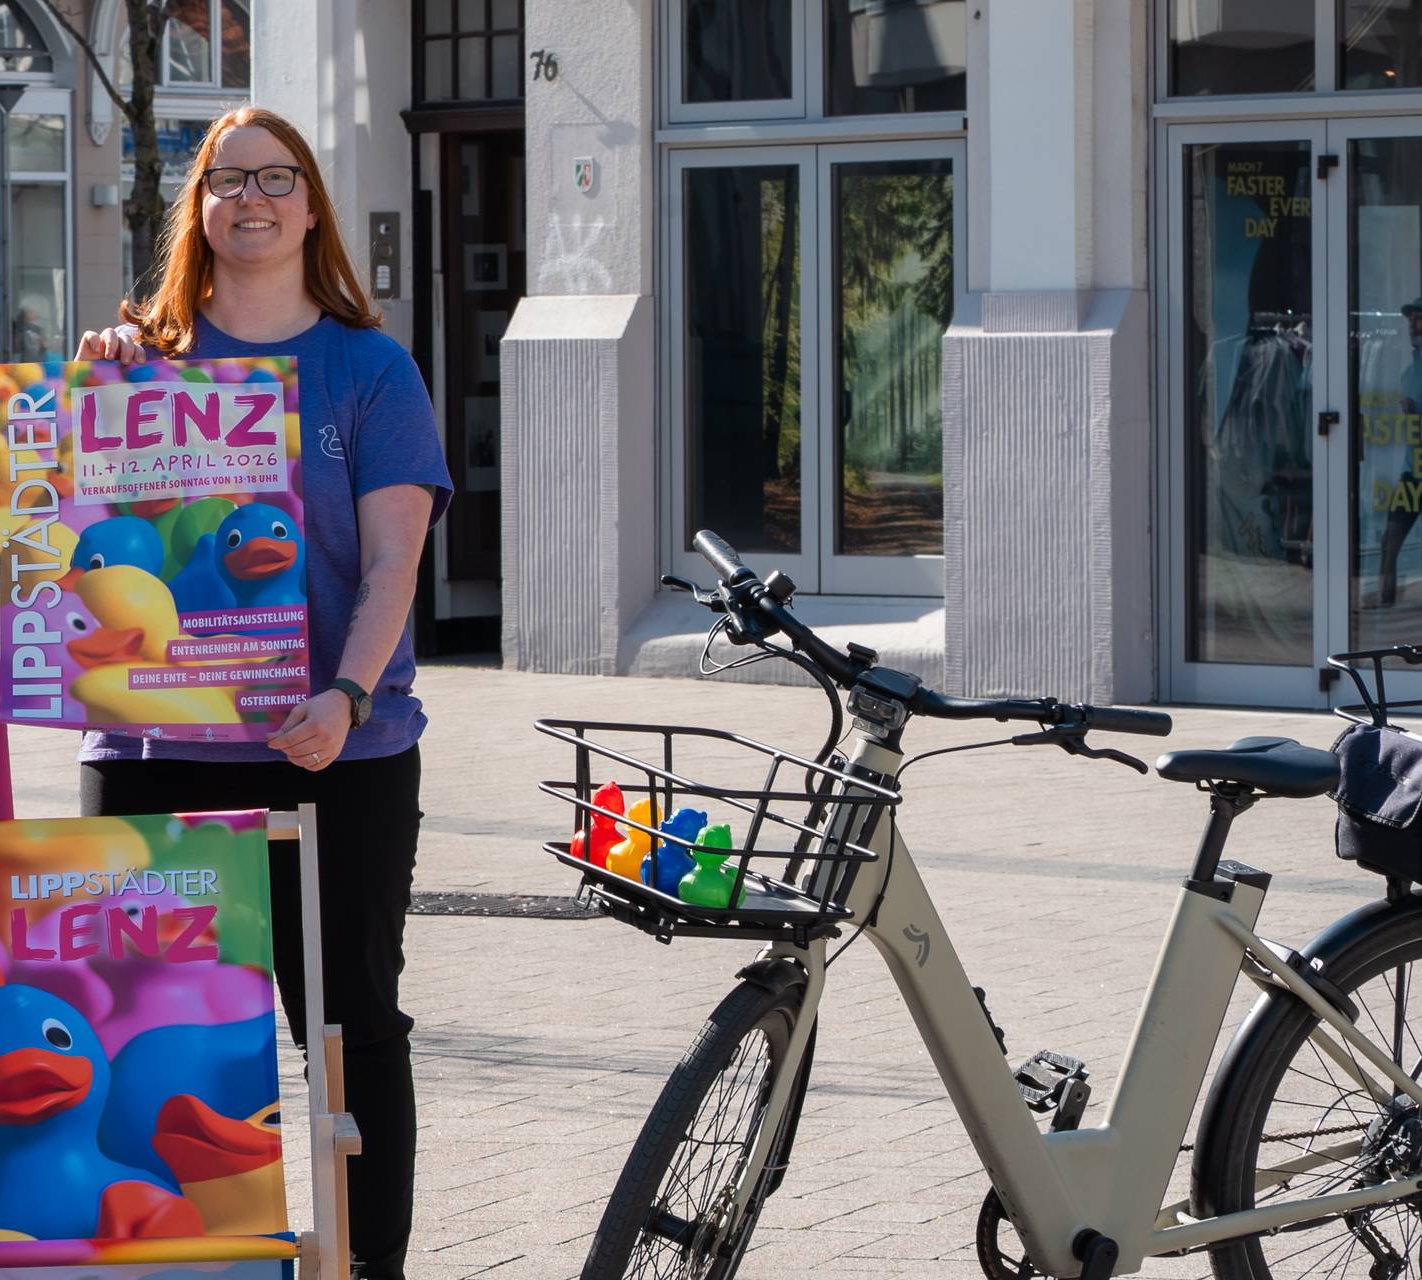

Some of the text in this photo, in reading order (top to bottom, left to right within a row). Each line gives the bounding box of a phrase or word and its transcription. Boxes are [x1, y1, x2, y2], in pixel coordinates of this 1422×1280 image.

[530, 49, 558, 82] 76
[1227, 176, 1285, 196] FASTER
[1270, 197, 1310, 217] EVER
[1245, 218, 1278, 238] DAY
[81, 388, 277, 453] LENZ
[152, 454, 216, 472] APRIL
[223, 452, 278, 467] 2026
[82, 474, 278, 496] VERKAUFSOFFENER SONNTAG VON 13-18 UHR
[2, 388, 63, 719] LIPPSTÄDTER
[182, 611, 304, 629] MOBILITÄTSAUSSTELLUNG
[171, 639, 305, 656] ENTENRENNEN AM SONNTAG
[133, 674, 161, 684] DEINE
[163, 672, 187, 683] ENTE
[199, 671, 227, 682] DEINE
[230, 666, 306, 680] GEWINNCHANCE
[240, 694, 307, 706] OSTERKIRMES
[11, 867, 220, 900] LIPPSTÄDTER
[10, 903, 219, 963] LENZ
